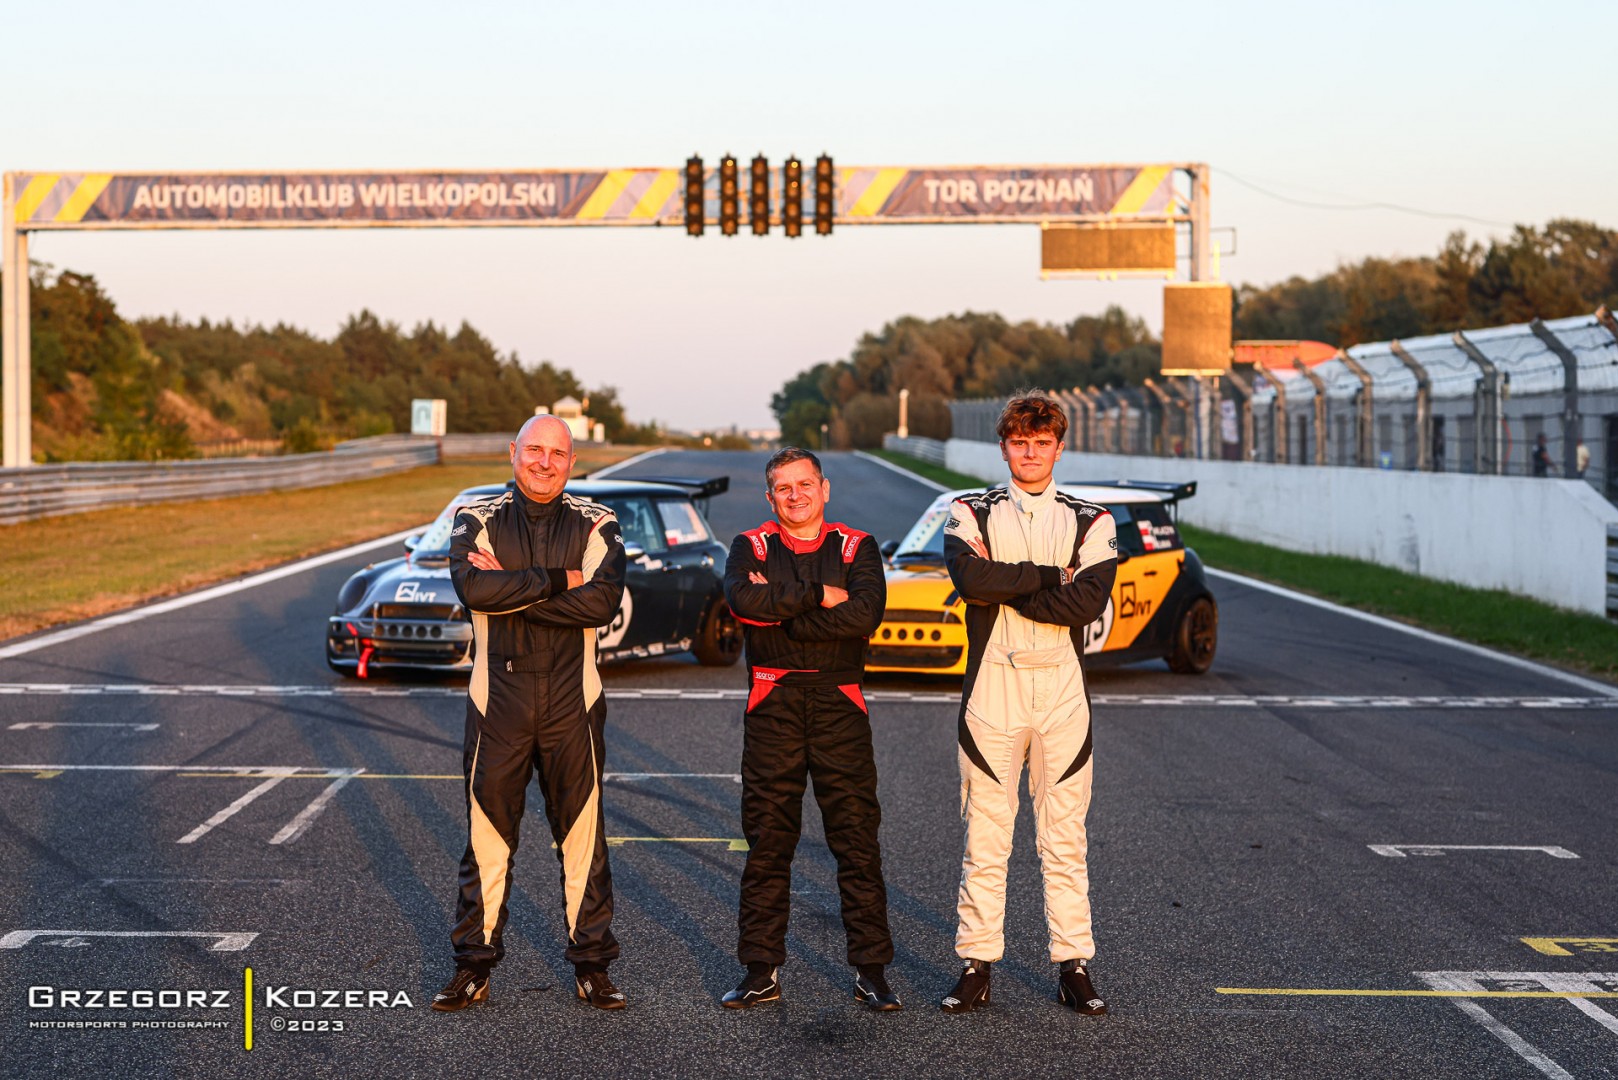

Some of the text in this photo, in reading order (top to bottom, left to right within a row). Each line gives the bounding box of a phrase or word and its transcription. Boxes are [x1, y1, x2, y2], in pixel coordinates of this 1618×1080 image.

[133, 181, 556, 209] AUTOMOBILKLUB WIELKOPOLSKI
[923, 173, 1094, 203] TOR POZNAŃ
